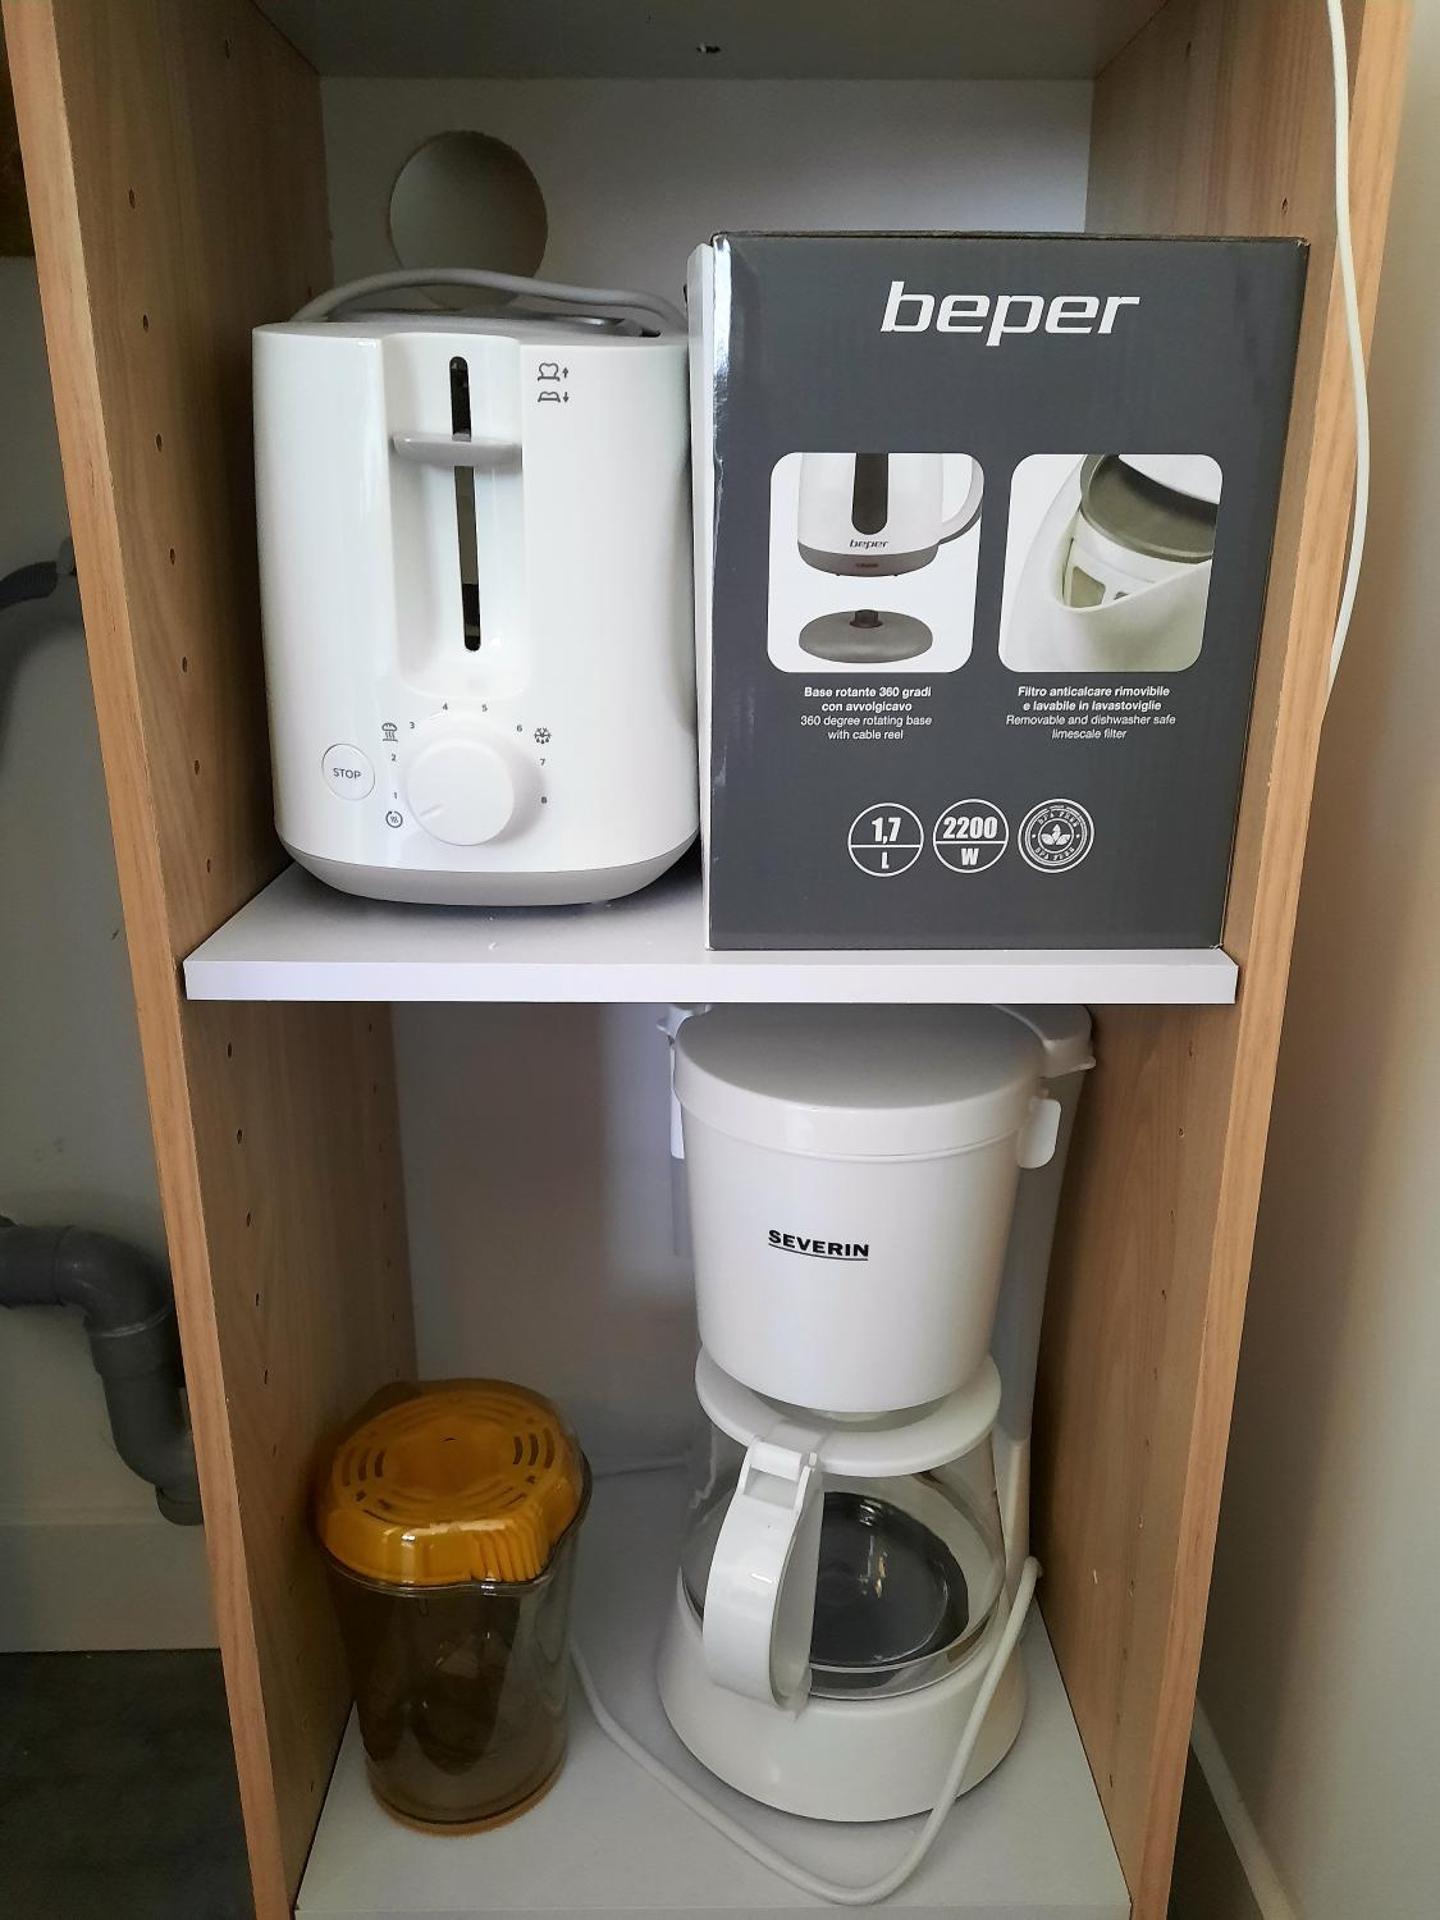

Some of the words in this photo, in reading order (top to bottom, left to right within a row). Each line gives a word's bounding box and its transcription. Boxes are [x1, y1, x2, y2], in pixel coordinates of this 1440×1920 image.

[880, 281, 1141, 347] beper
[850, 539, 888, 550] beper
[804, 687, 833, 697] Base
[835, 687, 876, 697] rotante
[879, 687, 899, 697] 360
[902, 687, 932, 699] gradi
[1018, 686, 1047, 697] Filtro
[1050, 686, 1112, 697] anticalcare
[1114, 685, 1170, 697] rimovibile
[442, 703, 448, 711] 4
[482, 704, 488, 712] 5
[822, 703, 843, 711] con
[846, 701, 912, 713] avvolgicavo
[1023, 703, 1031, 711] e
[1033, 701, 1076, 711] lavabile
[1078, 701, 1089, 711] in
[1091, 700, 1162, 713] lavastoviglie
[409, 721, 415, 730] 3
[800, 715, 821, 726] 360
[823, 716, 860, 728] degree
[863, 715, 903, 728] rotating
[906, 715, 933, 726] base
[1006, 714, 1066, 725] Removable
[1068, 714, 1088, 725] and
[1090, 714, 1151, 725] dishwasher
[1153, 714, 1176, 725] safe
[516, 725, 523, 733] 6
[828, 730, 850, 740] with
[852, 730, 881, 740] cable
[884, 730, 903, 740] reel
[1052, 728, 1101, 739] limescale
[1103, 728, 1127, 739] filter
[391, 753, 397, 762] 2
[540, 758, 546, 766] 7
[333, 767, 361, 780] STOP
[872, 816, 901, 844] 1,7
[942, 816, 998, 839] 2200
[881, 852, 890, 869] L
[961, 848, 979, 865] W
[768, 1229, 869, 1257] SEVERIN
